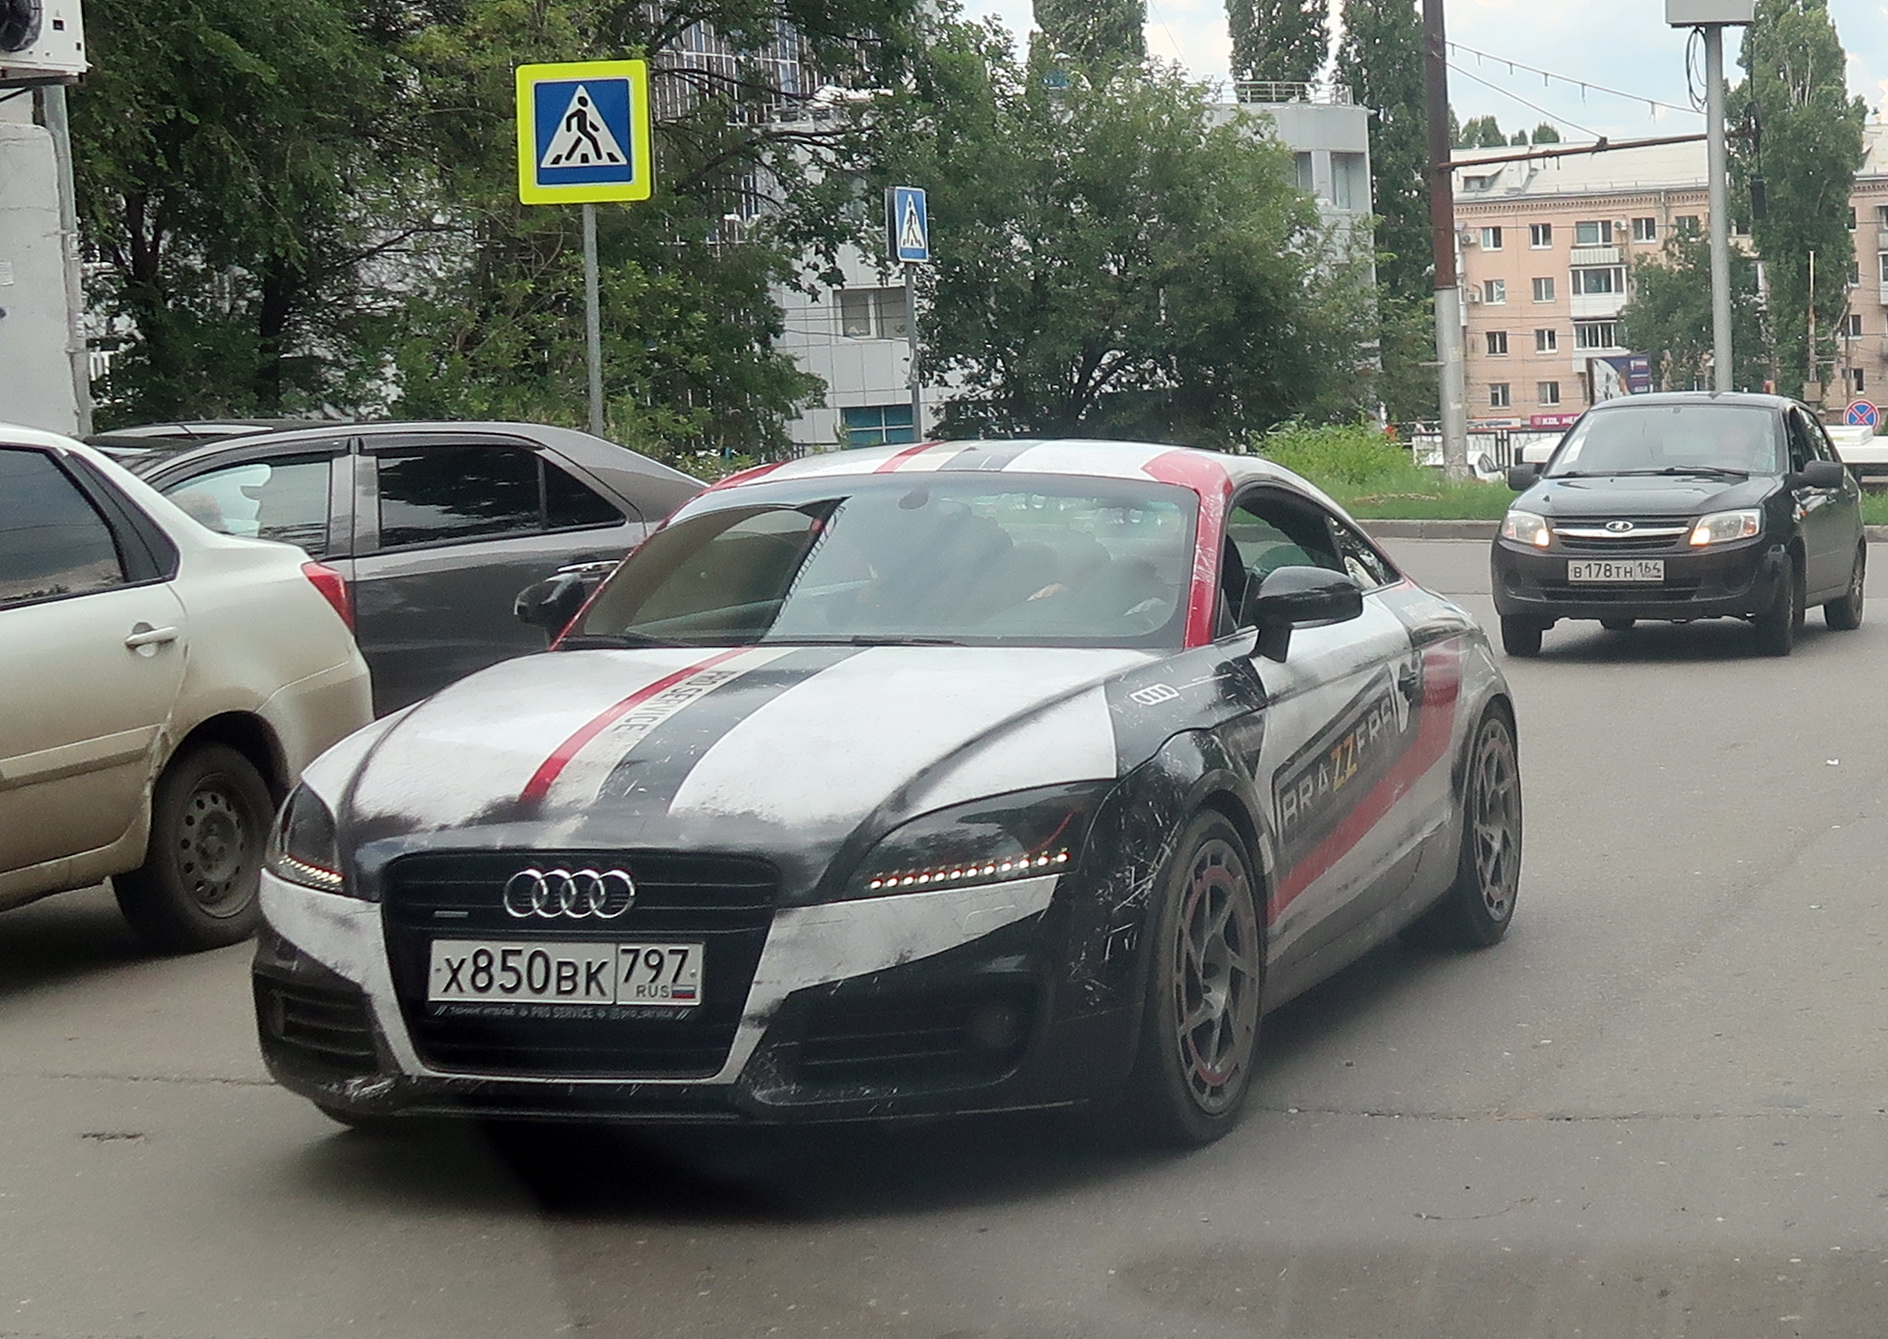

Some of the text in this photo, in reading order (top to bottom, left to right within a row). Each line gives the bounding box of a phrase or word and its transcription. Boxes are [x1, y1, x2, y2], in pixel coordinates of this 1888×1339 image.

[1574, 562, 1662, 578] В178ТН 164
[613, 687, 703, 732] SERVICE
[443, 948, 689, 996] Х850ВК 797
[635, 985, 670, 998] RUS
